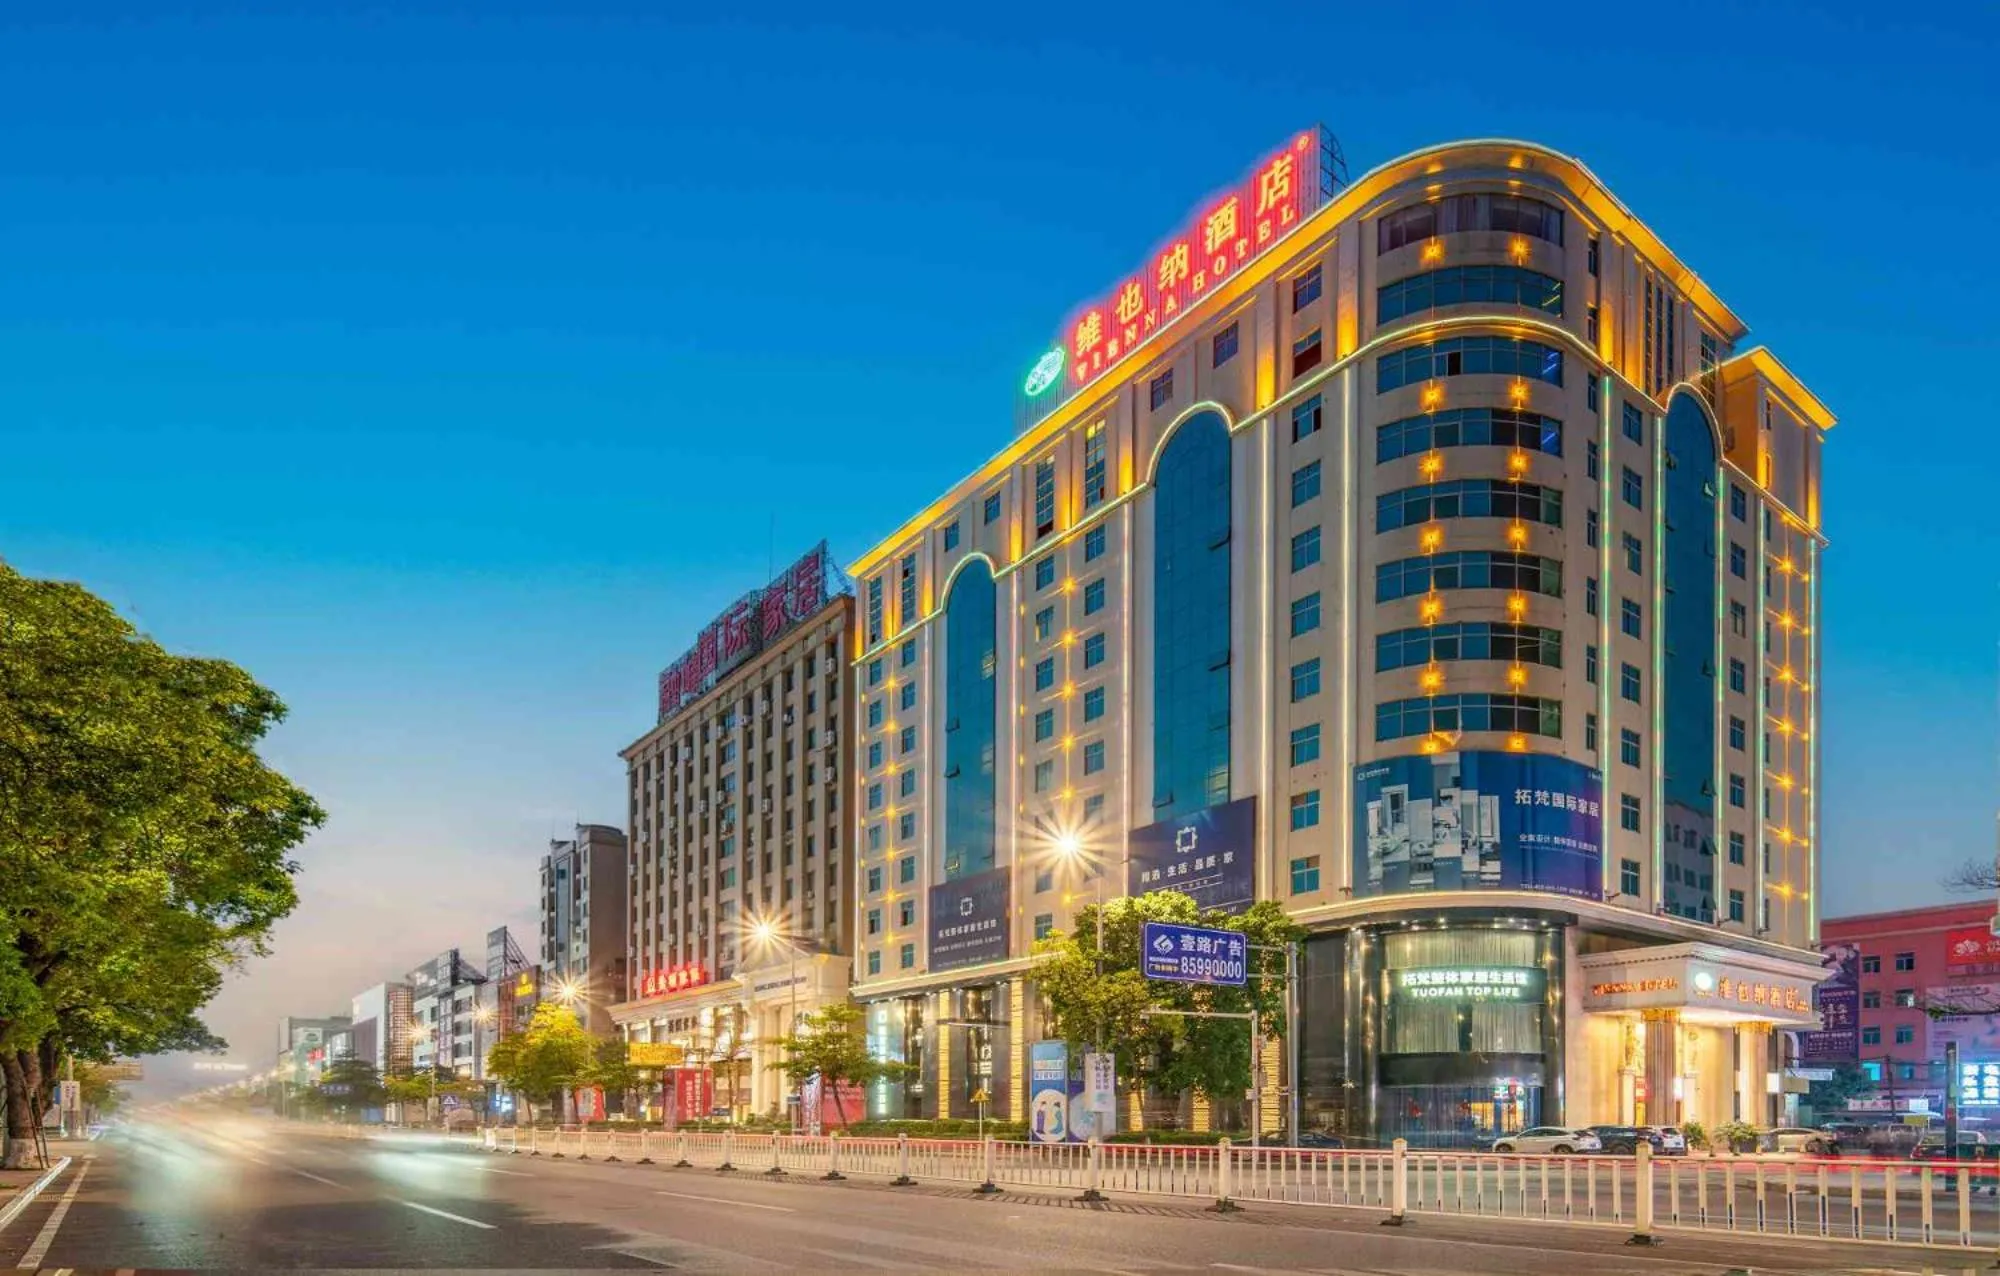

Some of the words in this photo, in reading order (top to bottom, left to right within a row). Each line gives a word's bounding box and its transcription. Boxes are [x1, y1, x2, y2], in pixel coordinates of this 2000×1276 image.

[1075, 153, 1294, 355] 维也纳酒店
[1076, 295, 1178, 381] VIENNA
[1192, 206, 1297, 294] HOTEL
[1180, 934, 1242, 957] 壹路广告
[1181, 956, 1242, 978] 85990000
[1412, 987, 1464, 998] TUOFAN
[1466, 986, 1491, 997] TOP
[1493, 987, 1520, 997] LIFE
